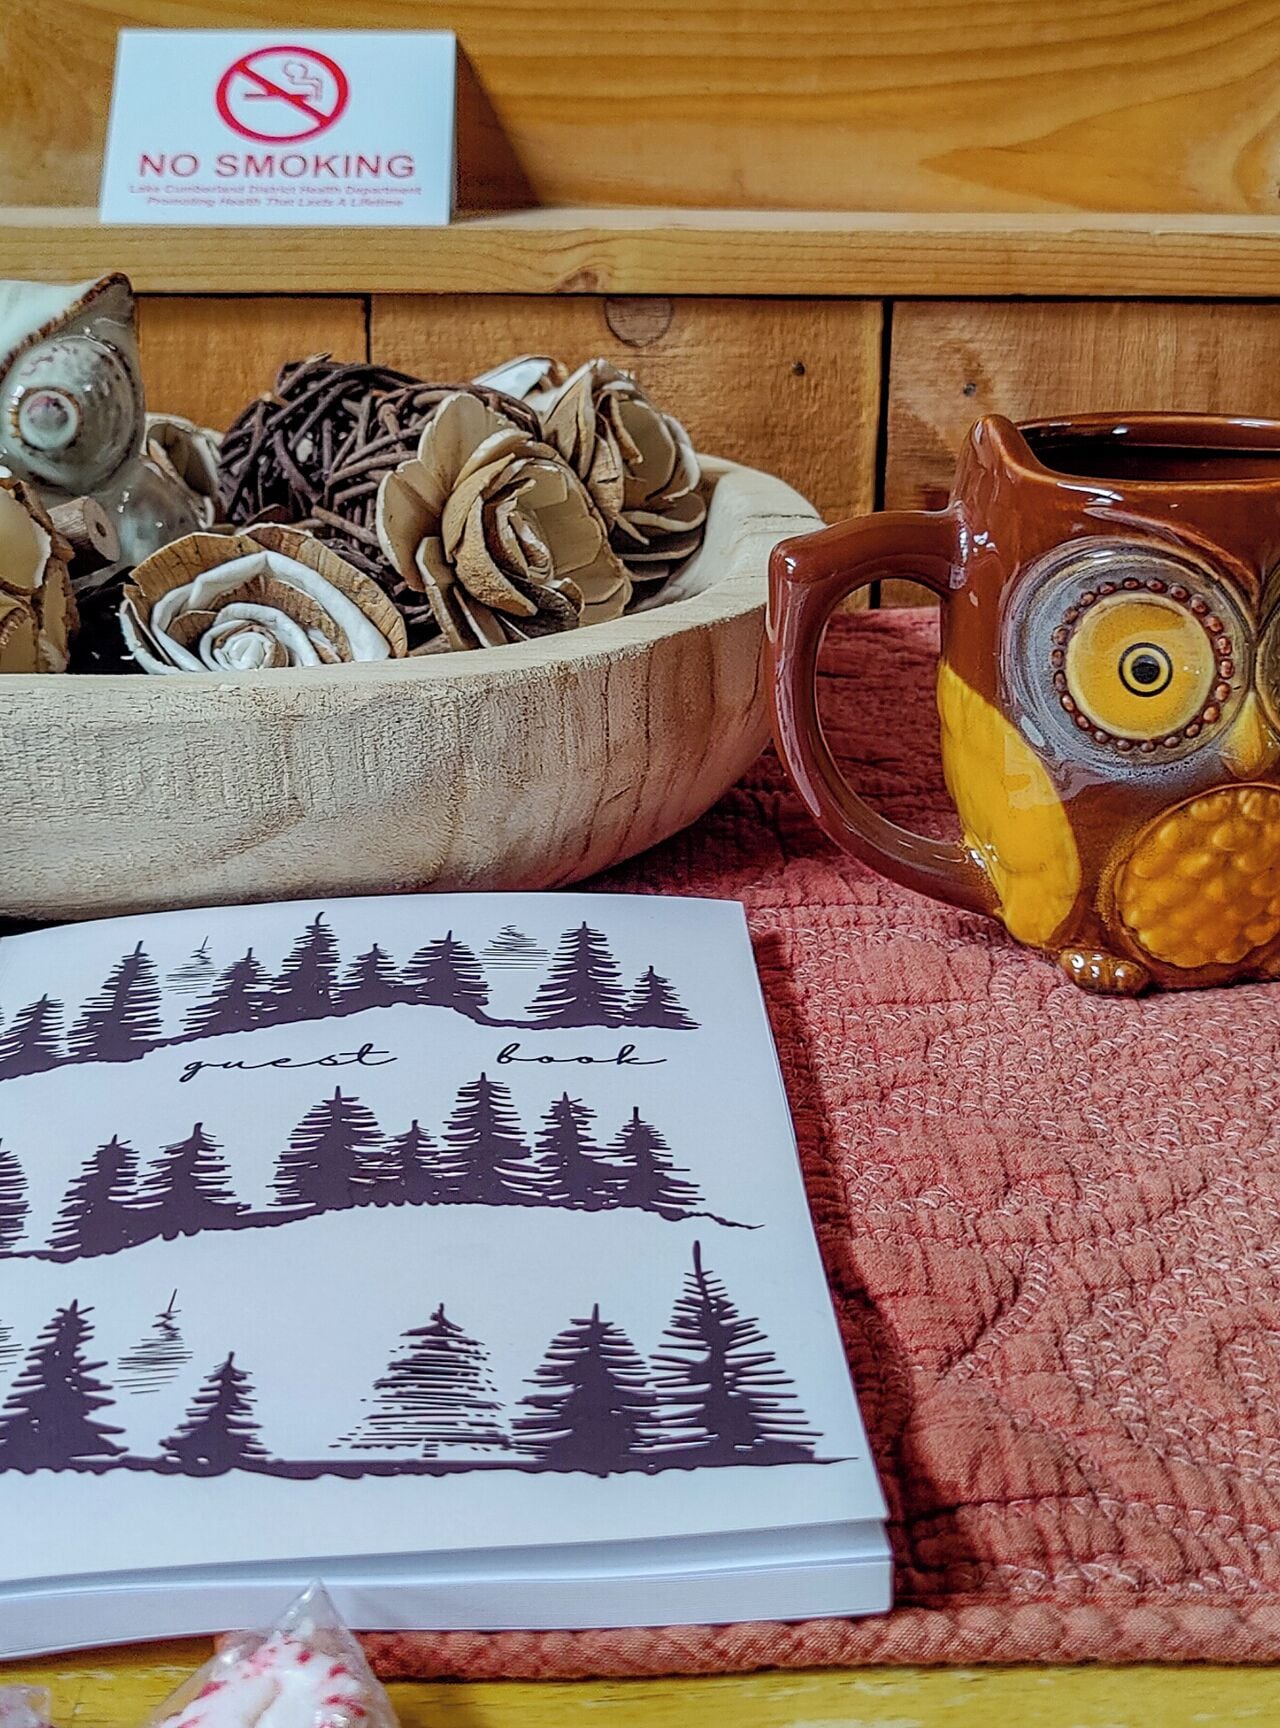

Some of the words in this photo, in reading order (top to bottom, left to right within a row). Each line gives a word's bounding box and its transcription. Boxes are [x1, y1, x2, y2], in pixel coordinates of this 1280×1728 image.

[138, 153, 200, 178] NO
[215, 153, 416, 179] SMOKING
[300, 185, 341, 195] Health
[345, 185, 422, 196] Department
[178, 1043, 398, 1083] guest
[496, 1042, 667, 1066] book
